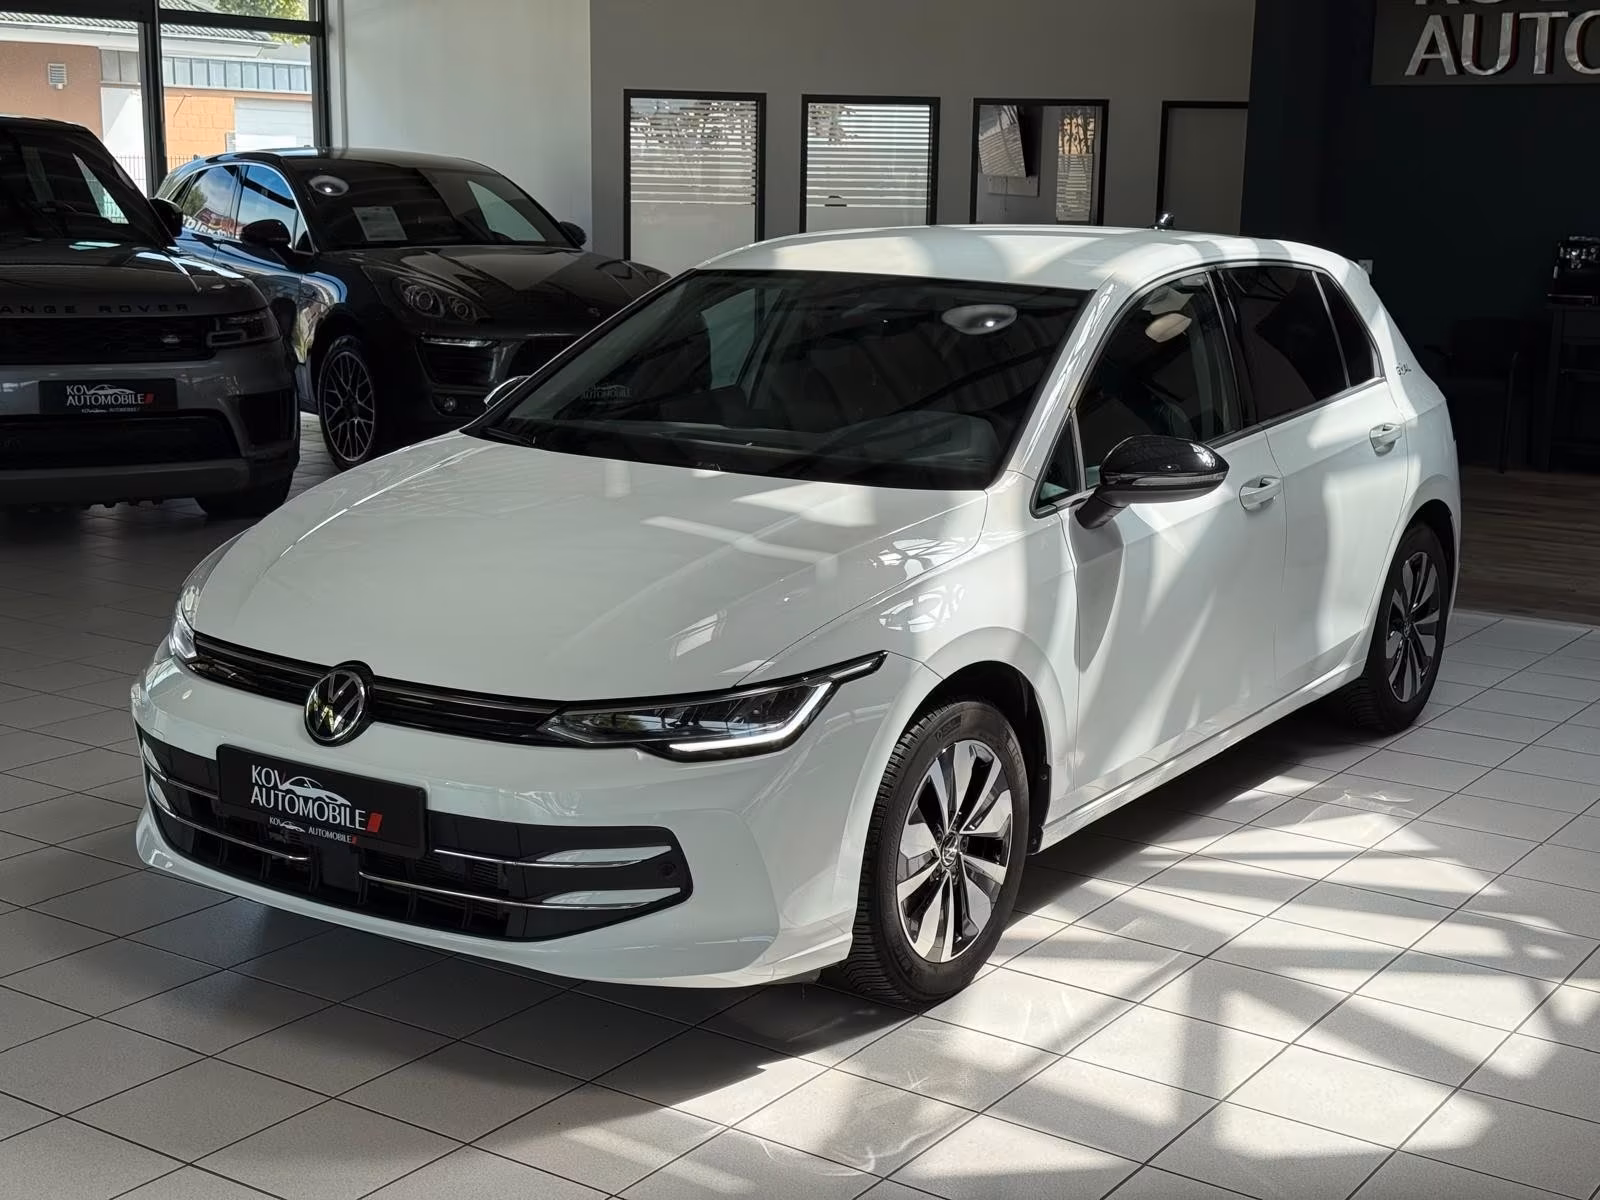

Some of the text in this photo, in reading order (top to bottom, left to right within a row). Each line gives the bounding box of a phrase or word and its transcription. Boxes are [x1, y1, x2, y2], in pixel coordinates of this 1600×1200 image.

[98, 303, 189, 313] ROVER
[66, 384, 91, 396] KOV
[66, 394, 145, 406] AUTOMOBILE
[251, 764, 287, 791] KOV
[250, 786, 367, 831] AUTOMOBILE
[269, 815, 353, 844] KOV AUTOMOBILE
